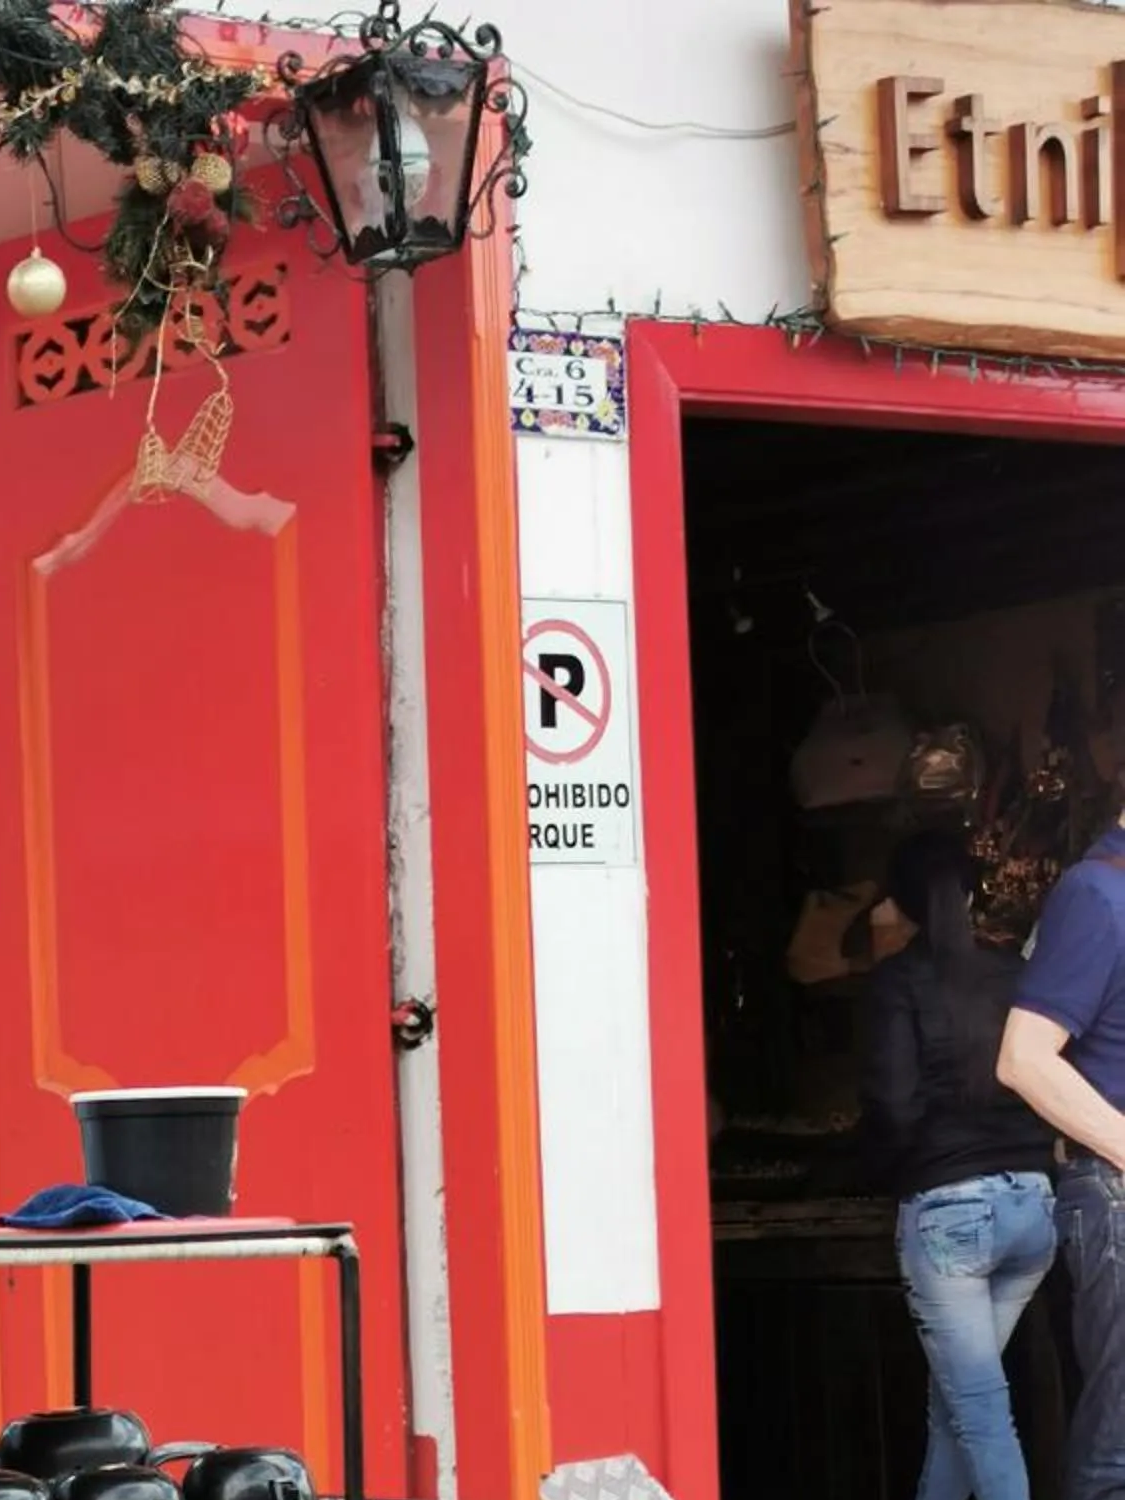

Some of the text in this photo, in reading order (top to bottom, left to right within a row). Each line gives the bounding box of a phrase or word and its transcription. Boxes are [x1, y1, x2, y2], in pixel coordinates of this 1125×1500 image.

[515, 356, 586, 381] Cra. 6
[514, 377, 594, 408] 4-15
[538, 653, 585, 729] P
